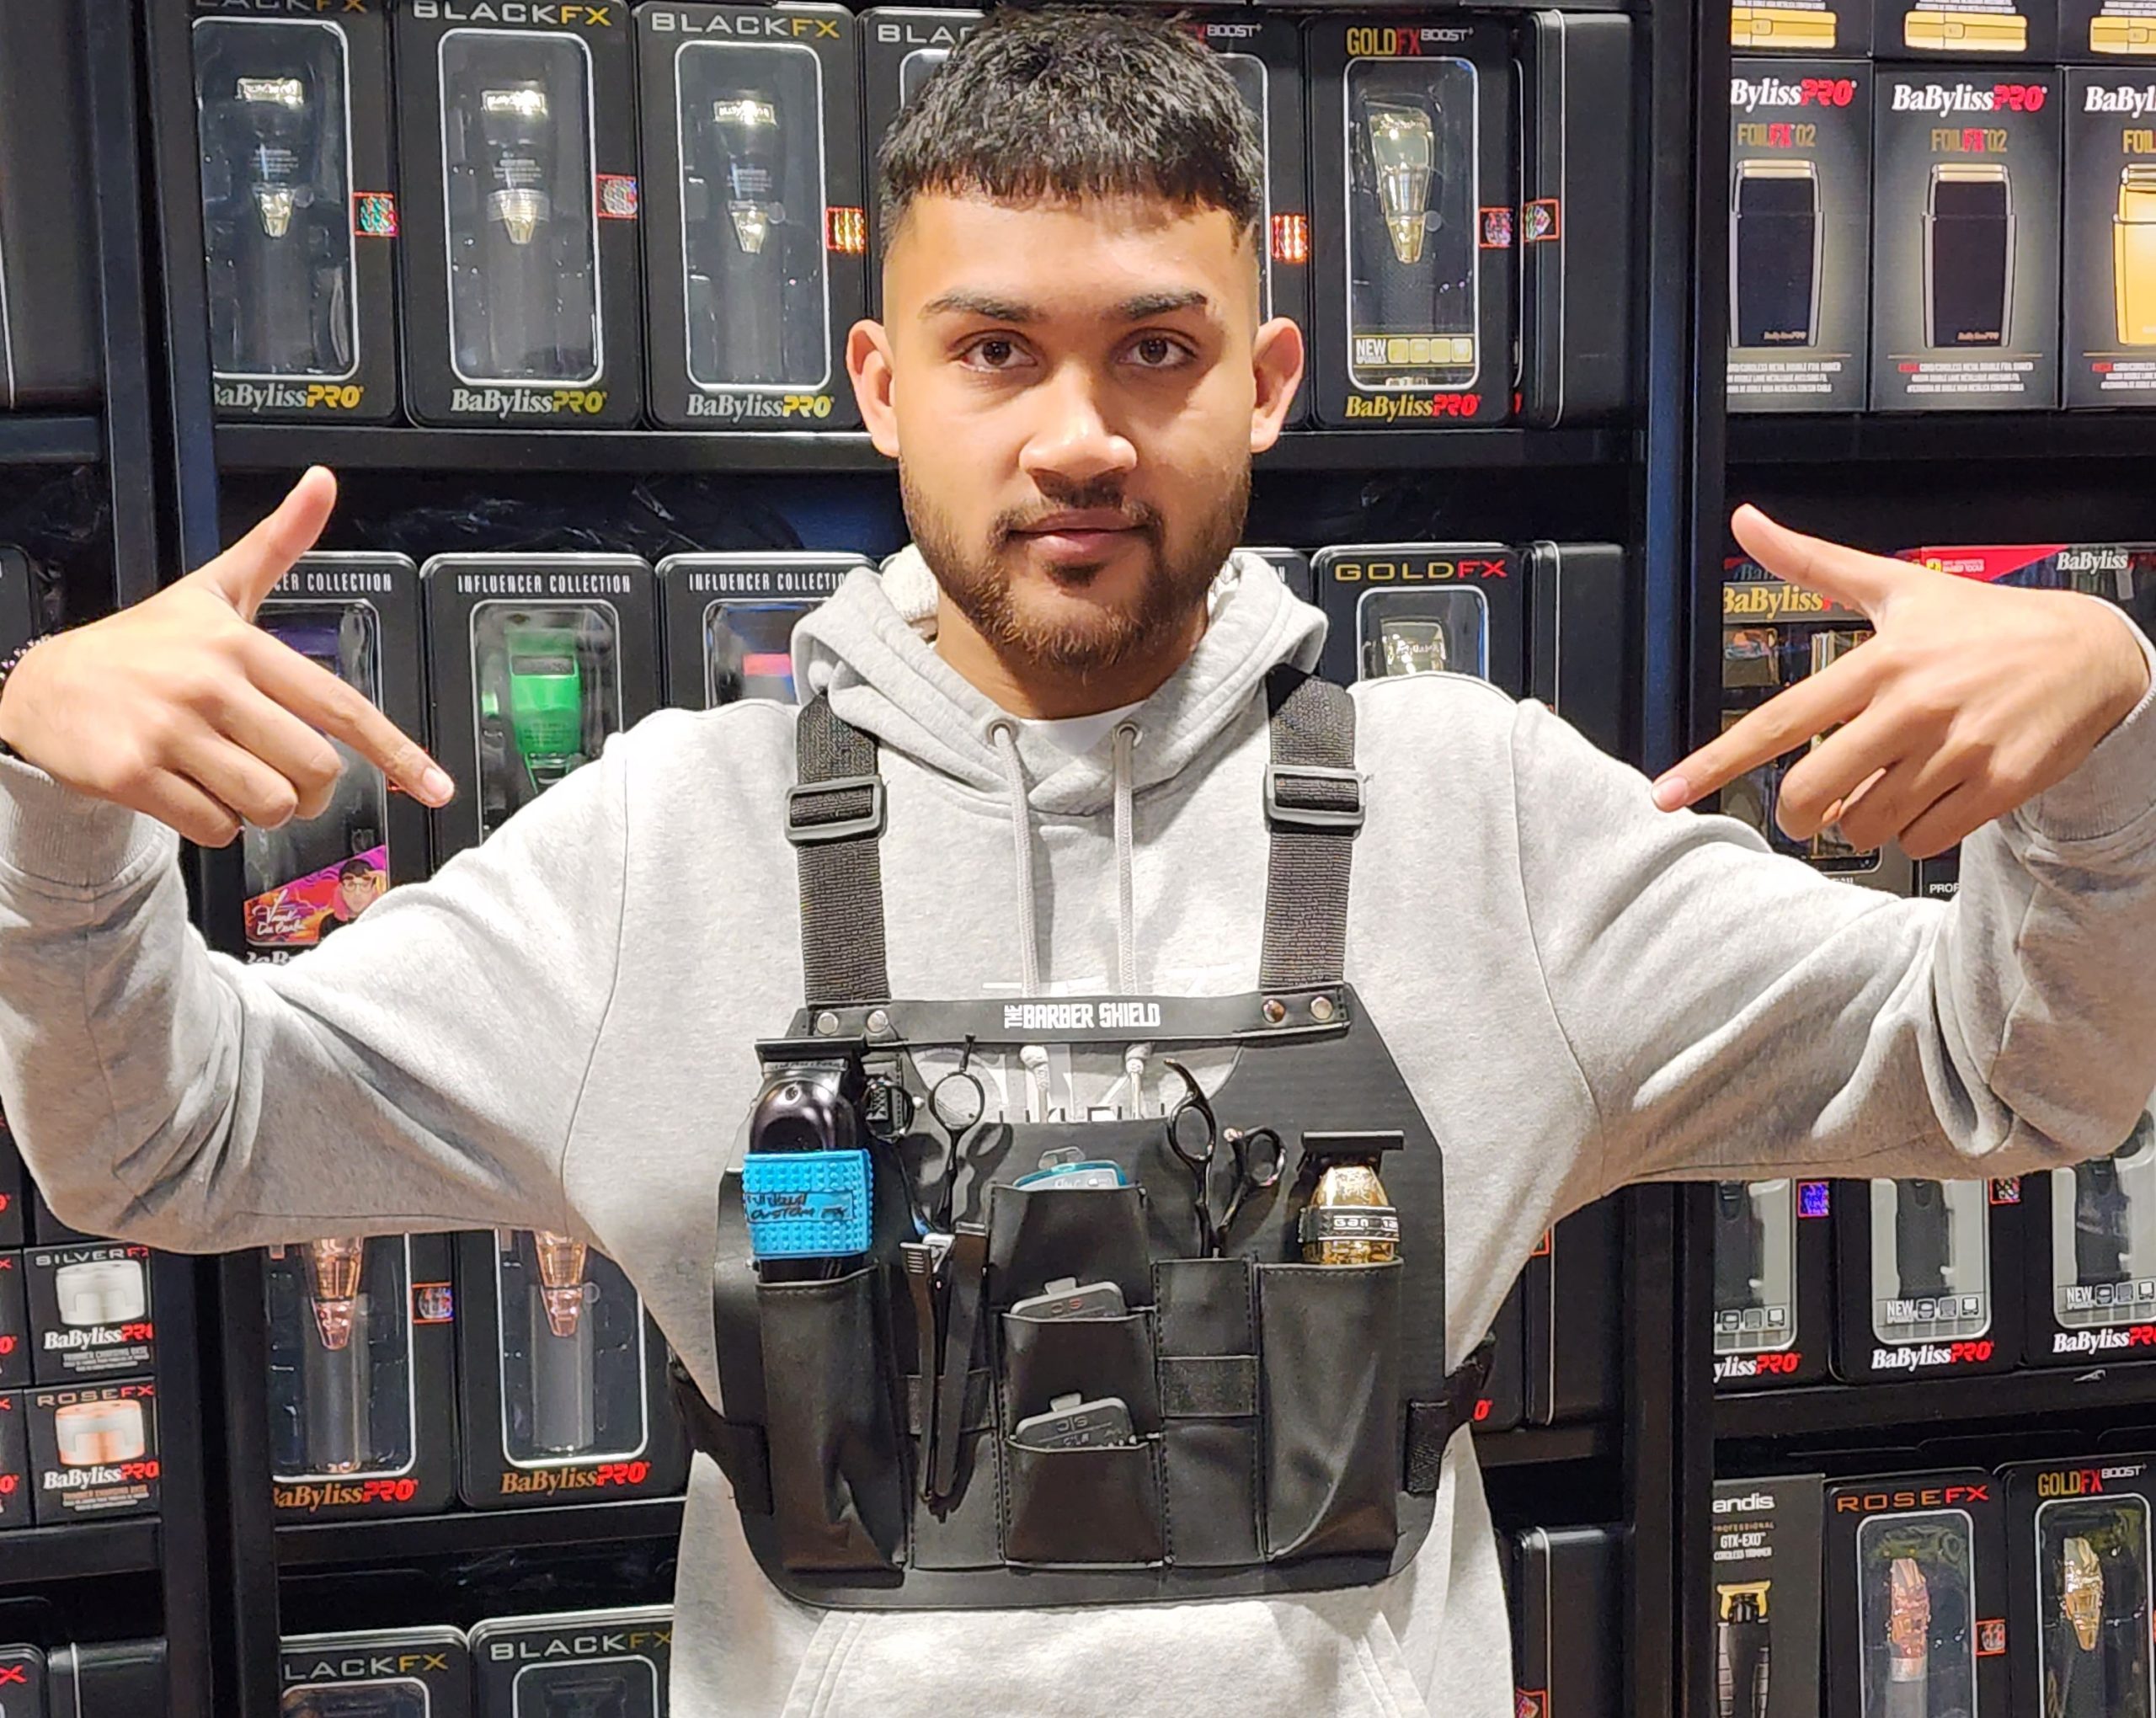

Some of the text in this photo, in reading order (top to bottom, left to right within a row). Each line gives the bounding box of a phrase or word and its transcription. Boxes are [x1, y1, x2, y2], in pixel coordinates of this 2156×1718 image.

[414, 0, 612, 26] BLACKFX
[651, 12, 841, 39] BLACKFX
[1347, 27, 1422, 56] GOLDFX
[1891, 83, 2047, 119] BaBylissPRO
[1356, 339, 1387, 358] NEW
[451, 388, 606, 419] BaBylissPRO
[686, 392, 835, 424] BaBylissPRO
[1344, 392, 1481, 421] BaBylissPRO
[307, 573, 392, 592] COLLECTION
[689, 573, 770, 592] INFLUENCER
[1335, 558, 1508, 582] GOLDFX
[456, 574, 631, 594] INFLUENCER COLLECTION
[1004, 1002, 1161, 1029] THE BARBER SHIELD
[1886, 1299, 1913, 1318] NEW
[2066, 1285, 2094, 1305] NEW
[1871, 1340, 1994, 1372] BaBylissPRO
[37, 1384, 155, 1408] ROSEFX
[43, 1460, 160, 1490] BaBylissPRO
[500, 1460, 650, 1496] BaBylissPRO
[2037, 1470, 2103, 1497] GOLDFX
[1713, 1491, 1775, 1513] andis
[1837, 1485, 1989, 1513] ROSEFX
[490, 1631, 672, 1662] BLACKFX
